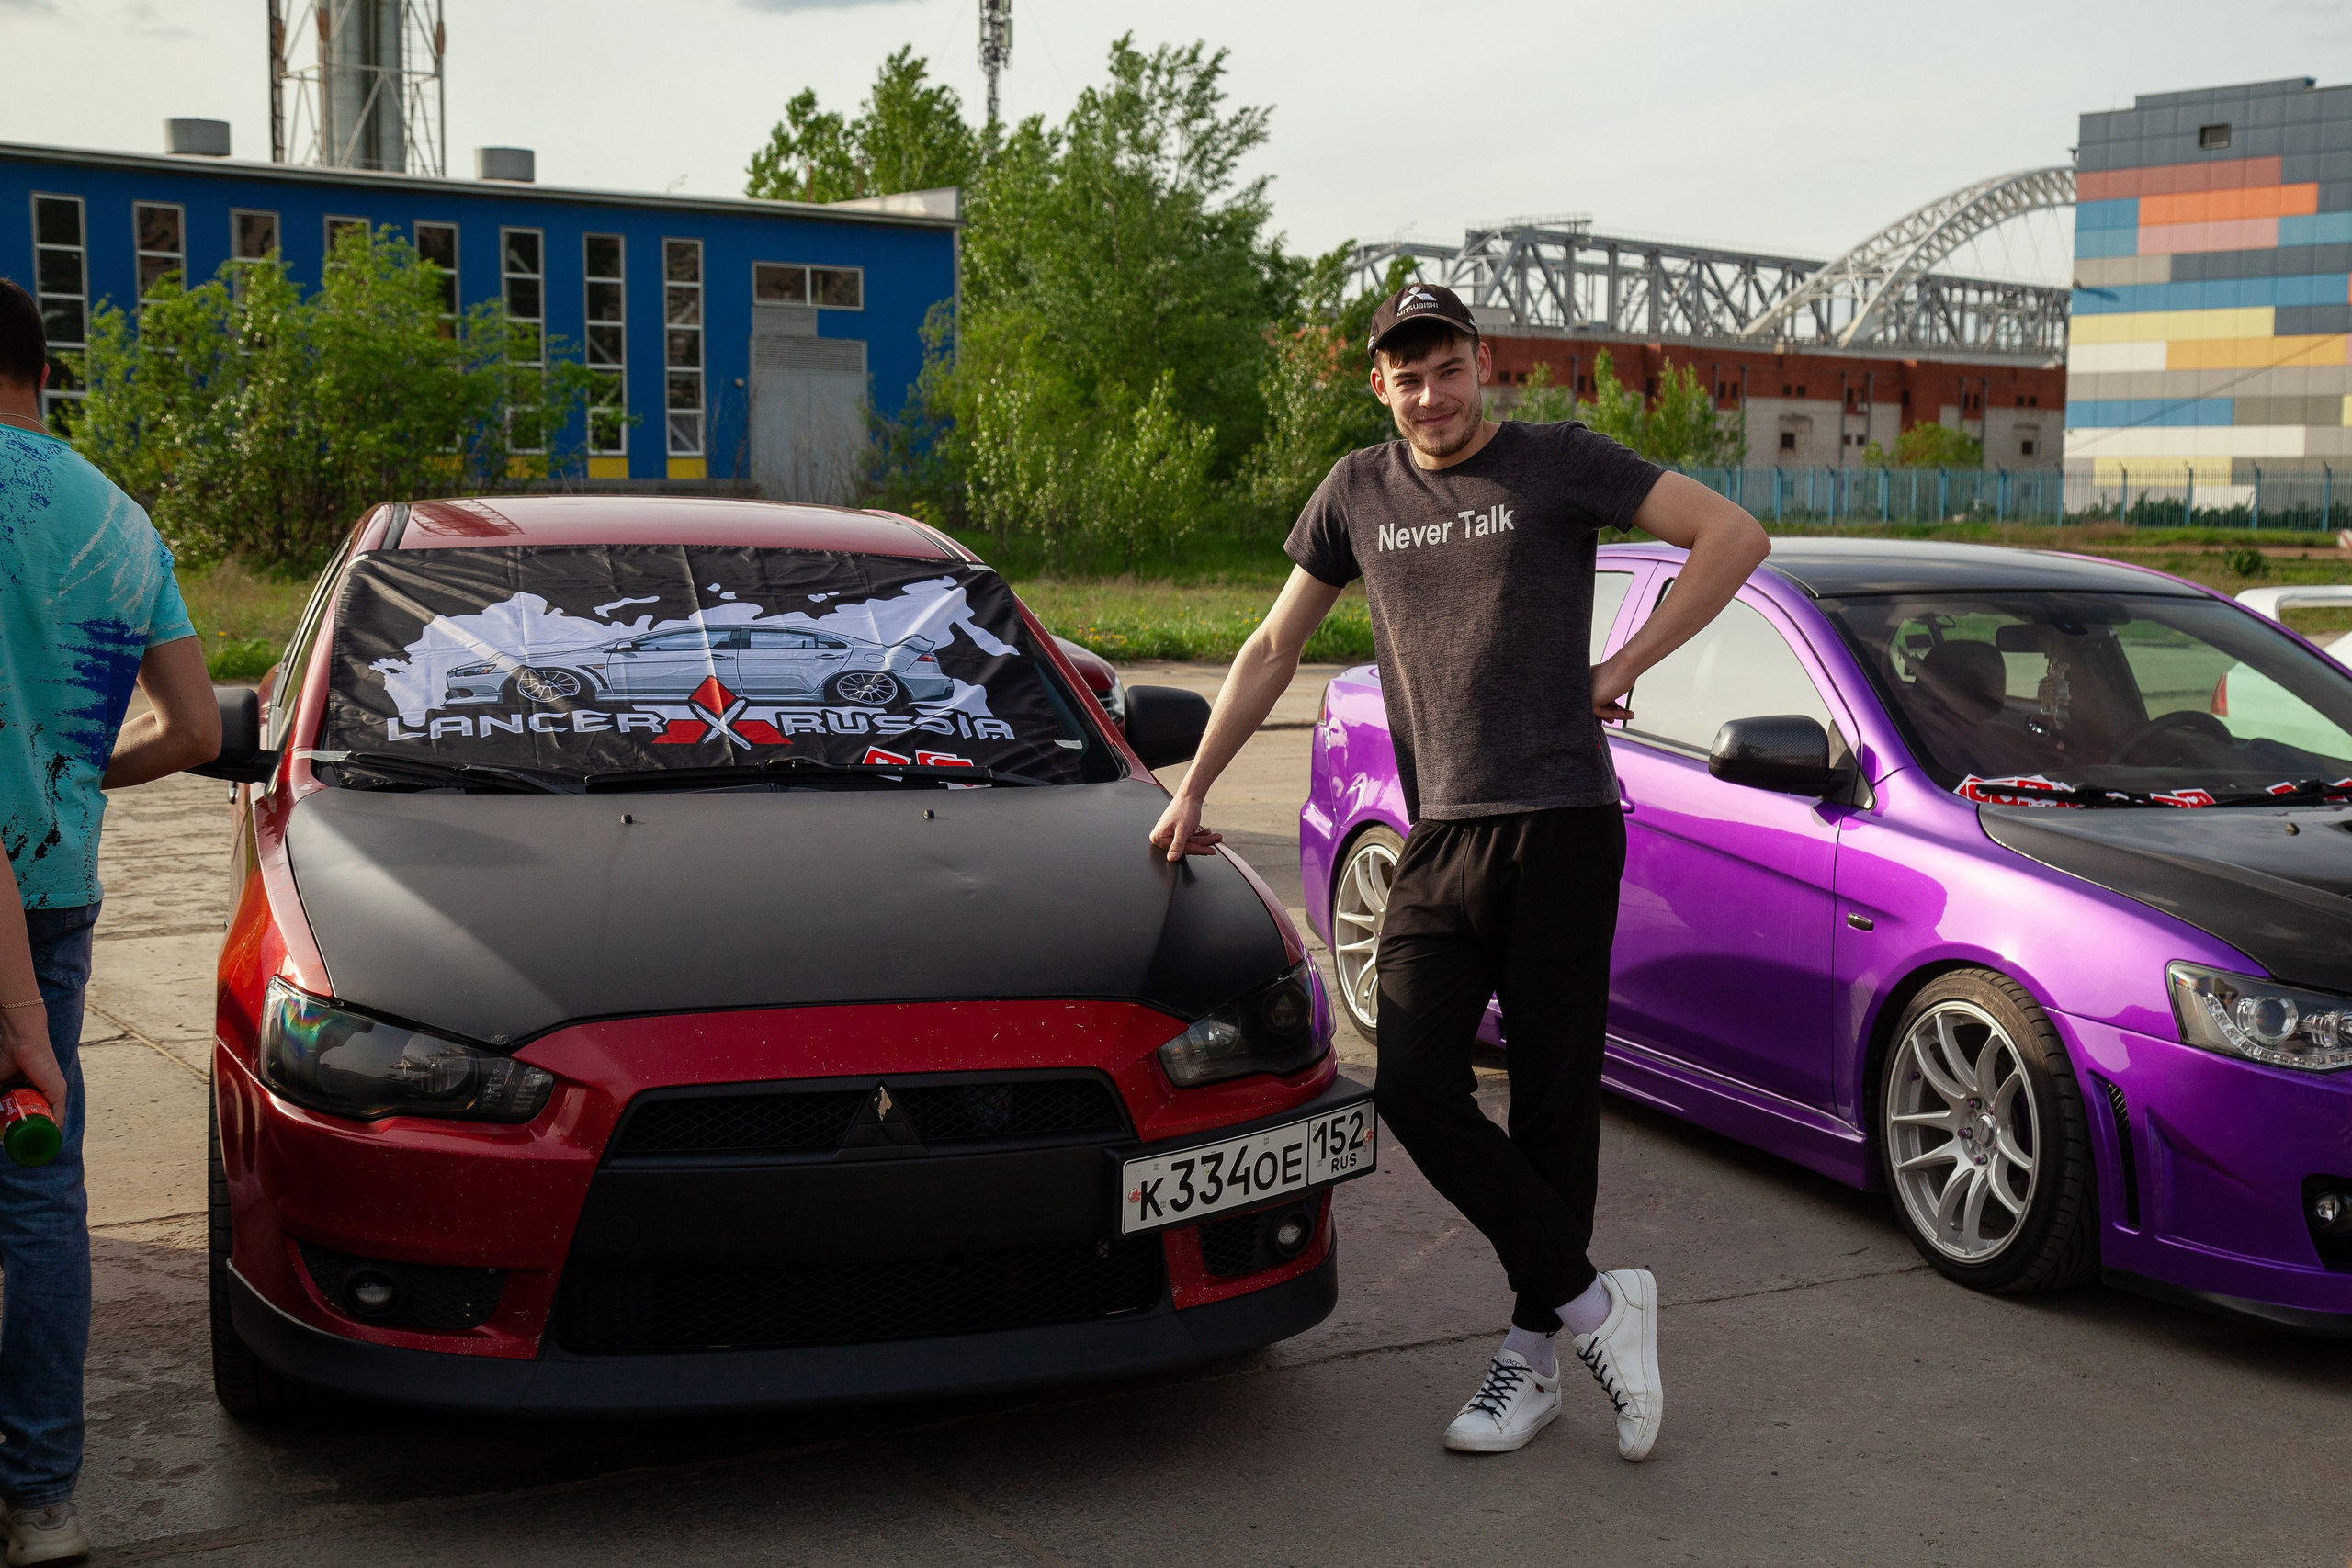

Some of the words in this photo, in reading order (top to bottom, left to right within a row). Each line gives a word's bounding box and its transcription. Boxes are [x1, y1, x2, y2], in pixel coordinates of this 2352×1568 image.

[1396, 302, 1439, 318] MITSUBISHI
[1378, 521, 1453, 552] Never
[1457, 503, 1515, 539] Talk
[386, 709, 667, 742] LANCER
[781, 707, 1016, 739] RUSSIA
[1312, 1111, 1364, 1160] 152
[1330, 1152, 1358, 1174] RUS
